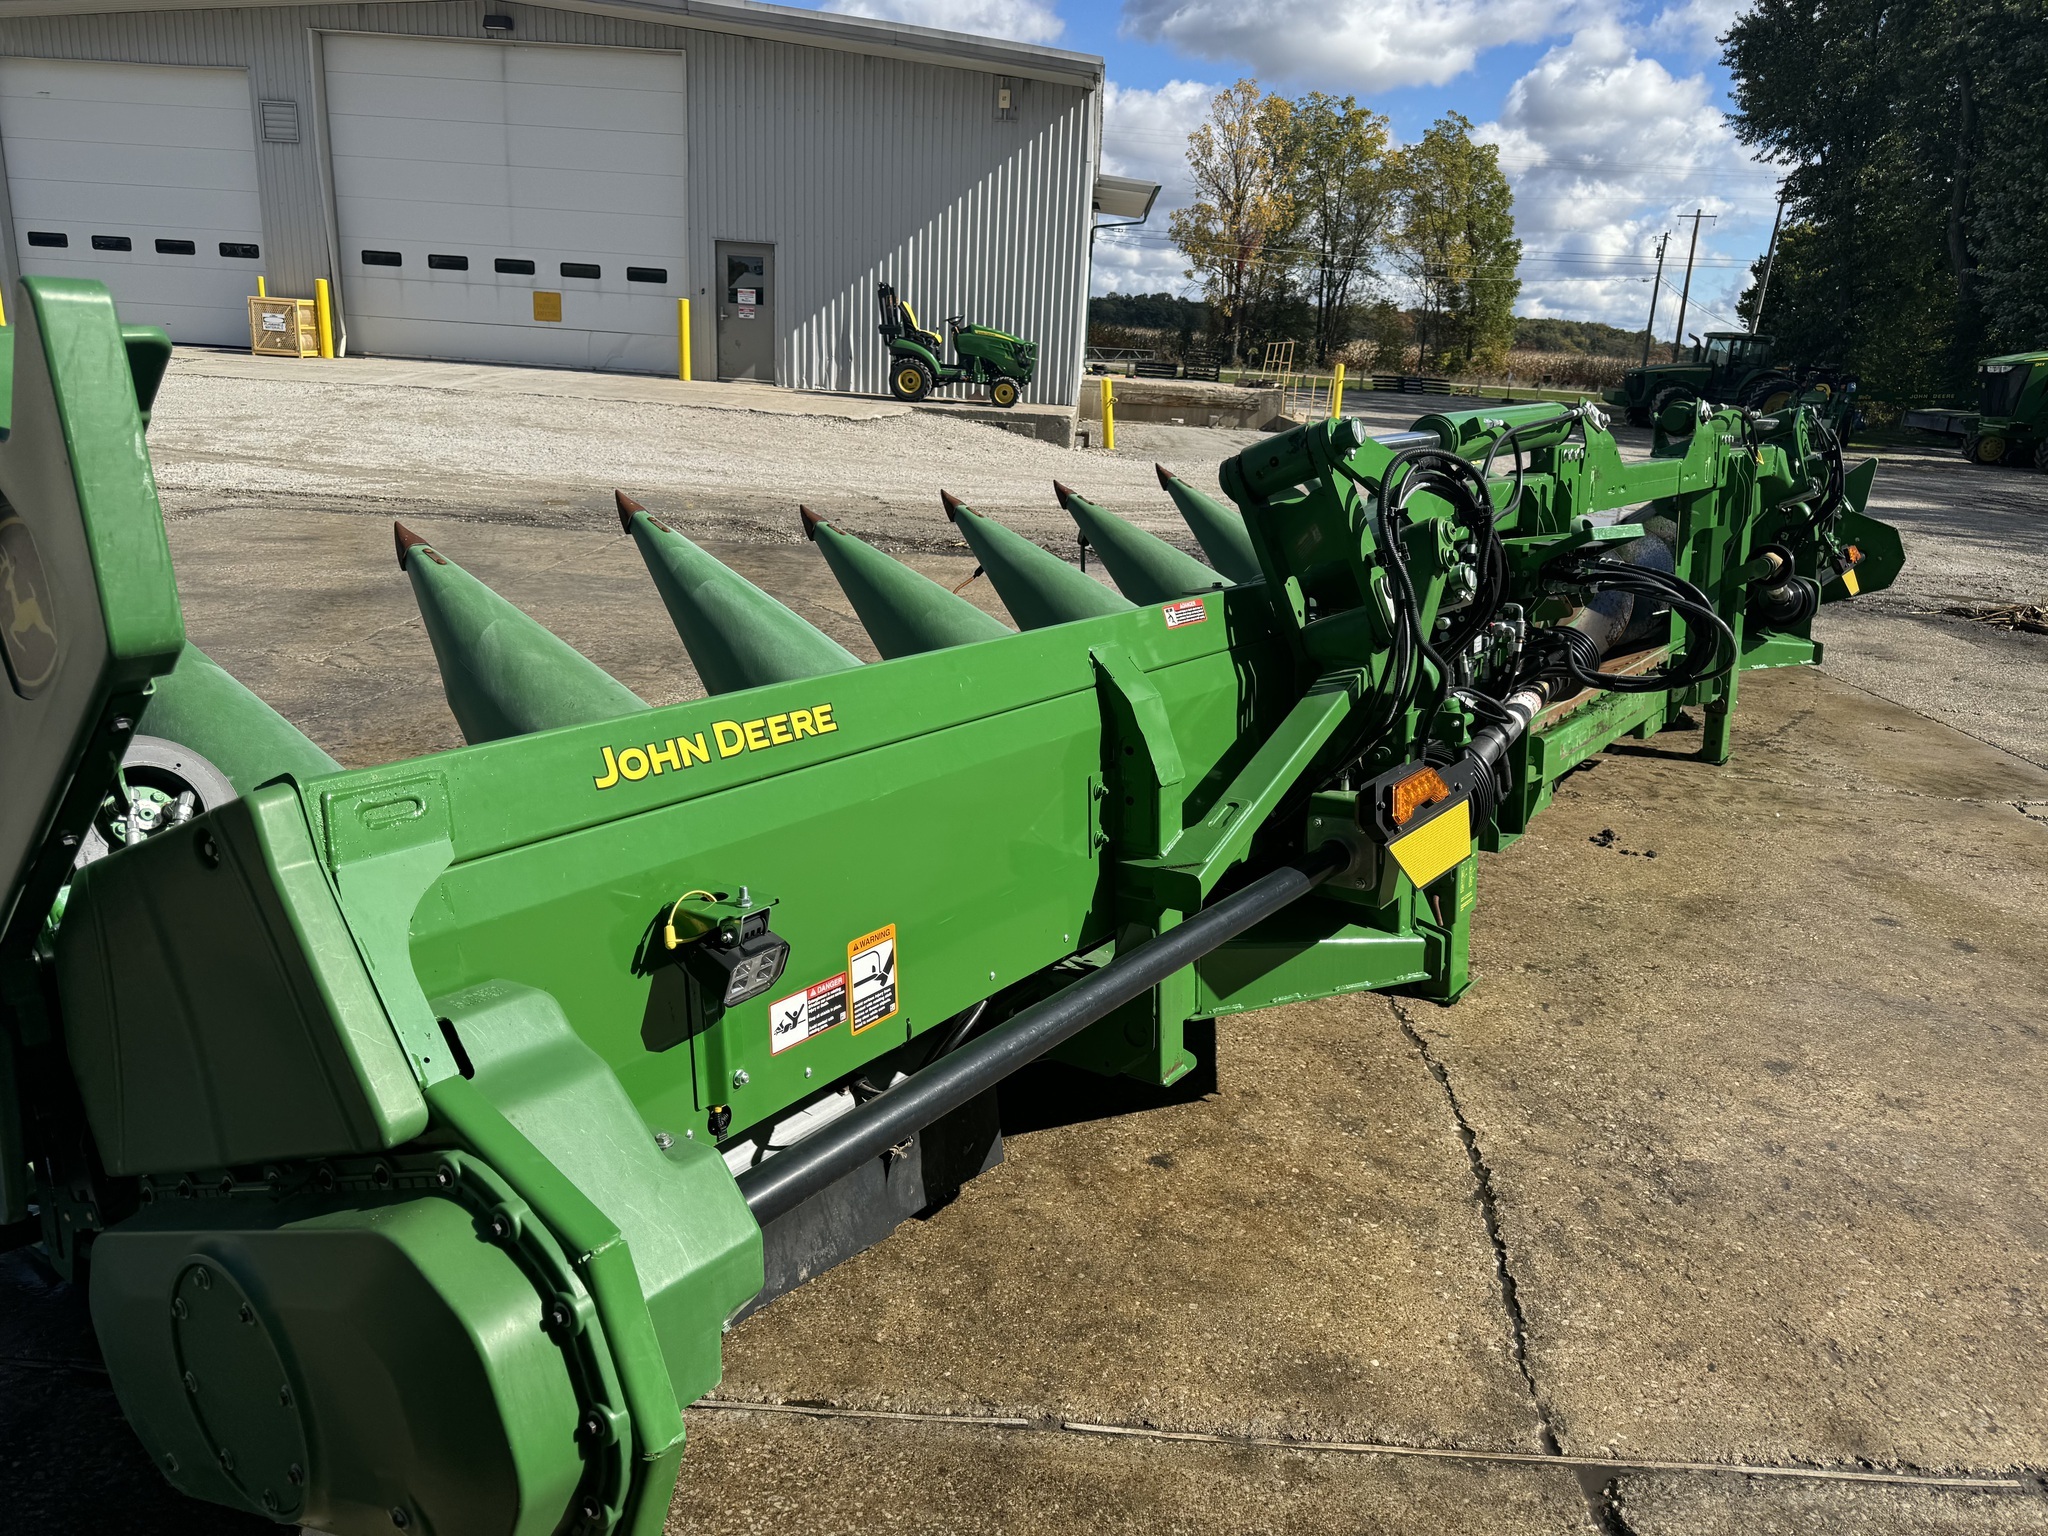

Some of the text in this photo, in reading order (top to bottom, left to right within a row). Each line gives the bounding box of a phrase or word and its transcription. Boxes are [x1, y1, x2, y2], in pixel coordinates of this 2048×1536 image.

[593, 702, 839, 791] JOHN DEERE
[859, 928, 891, 949] WARNING
[817, 977, 843, 994] DANGER
